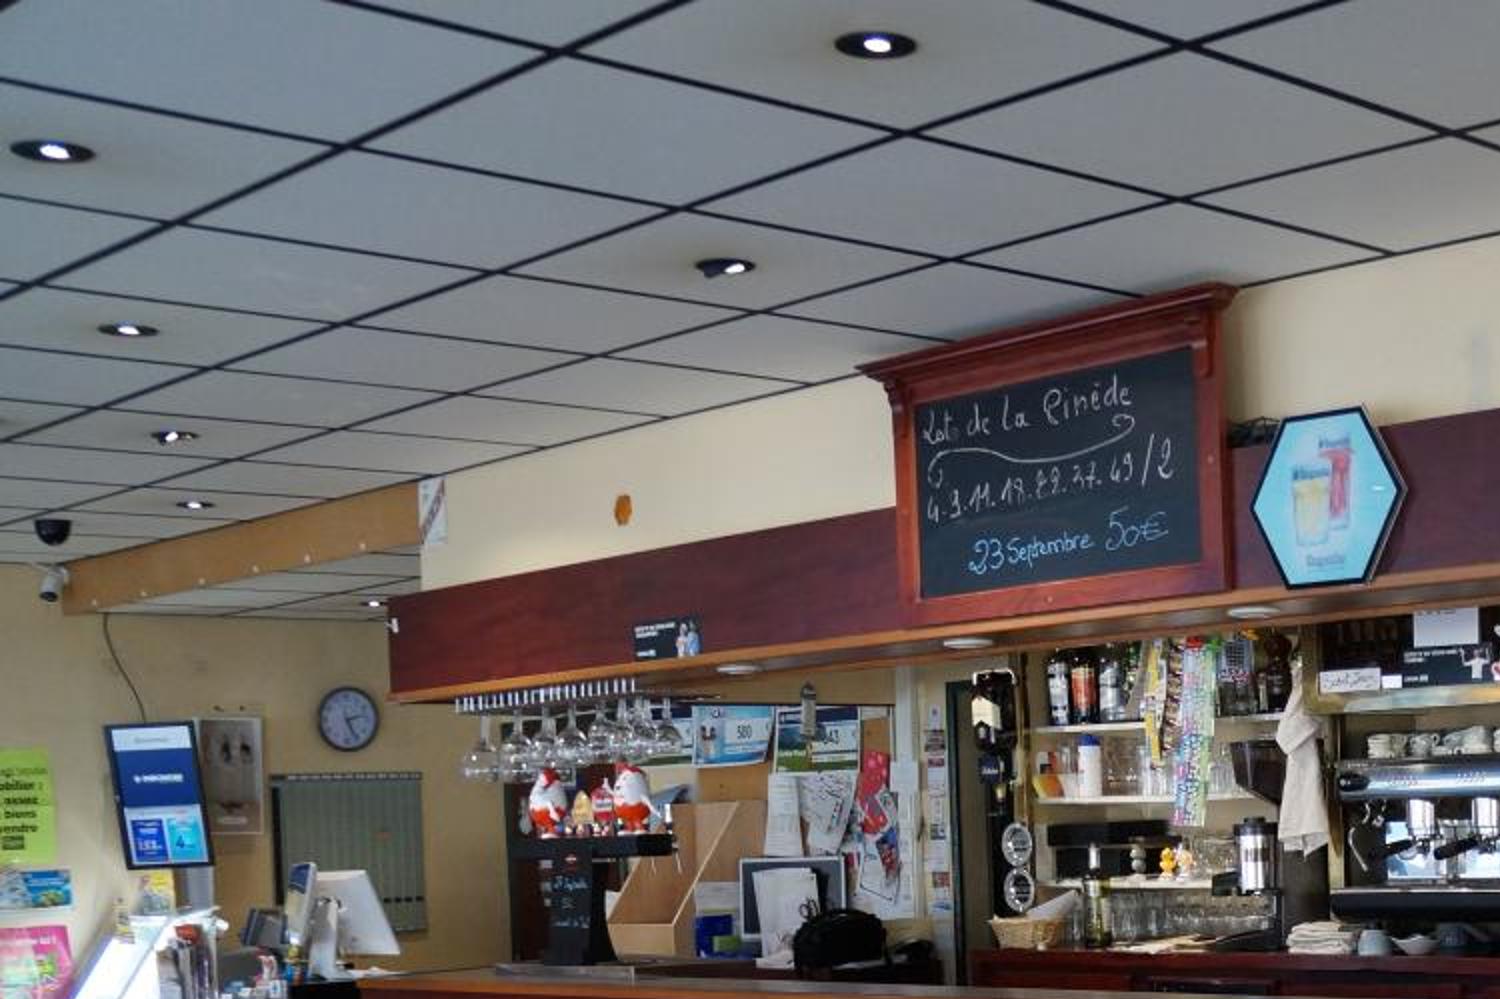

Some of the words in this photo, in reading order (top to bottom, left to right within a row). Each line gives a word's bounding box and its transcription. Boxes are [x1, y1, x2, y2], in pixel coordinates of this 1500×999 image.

[966, 402, 991, 436] de
[1001, 395, 1029, 431] la
[968, 539, 1005, 575] 23
[1006, 531, 1095, 568] Septembre
